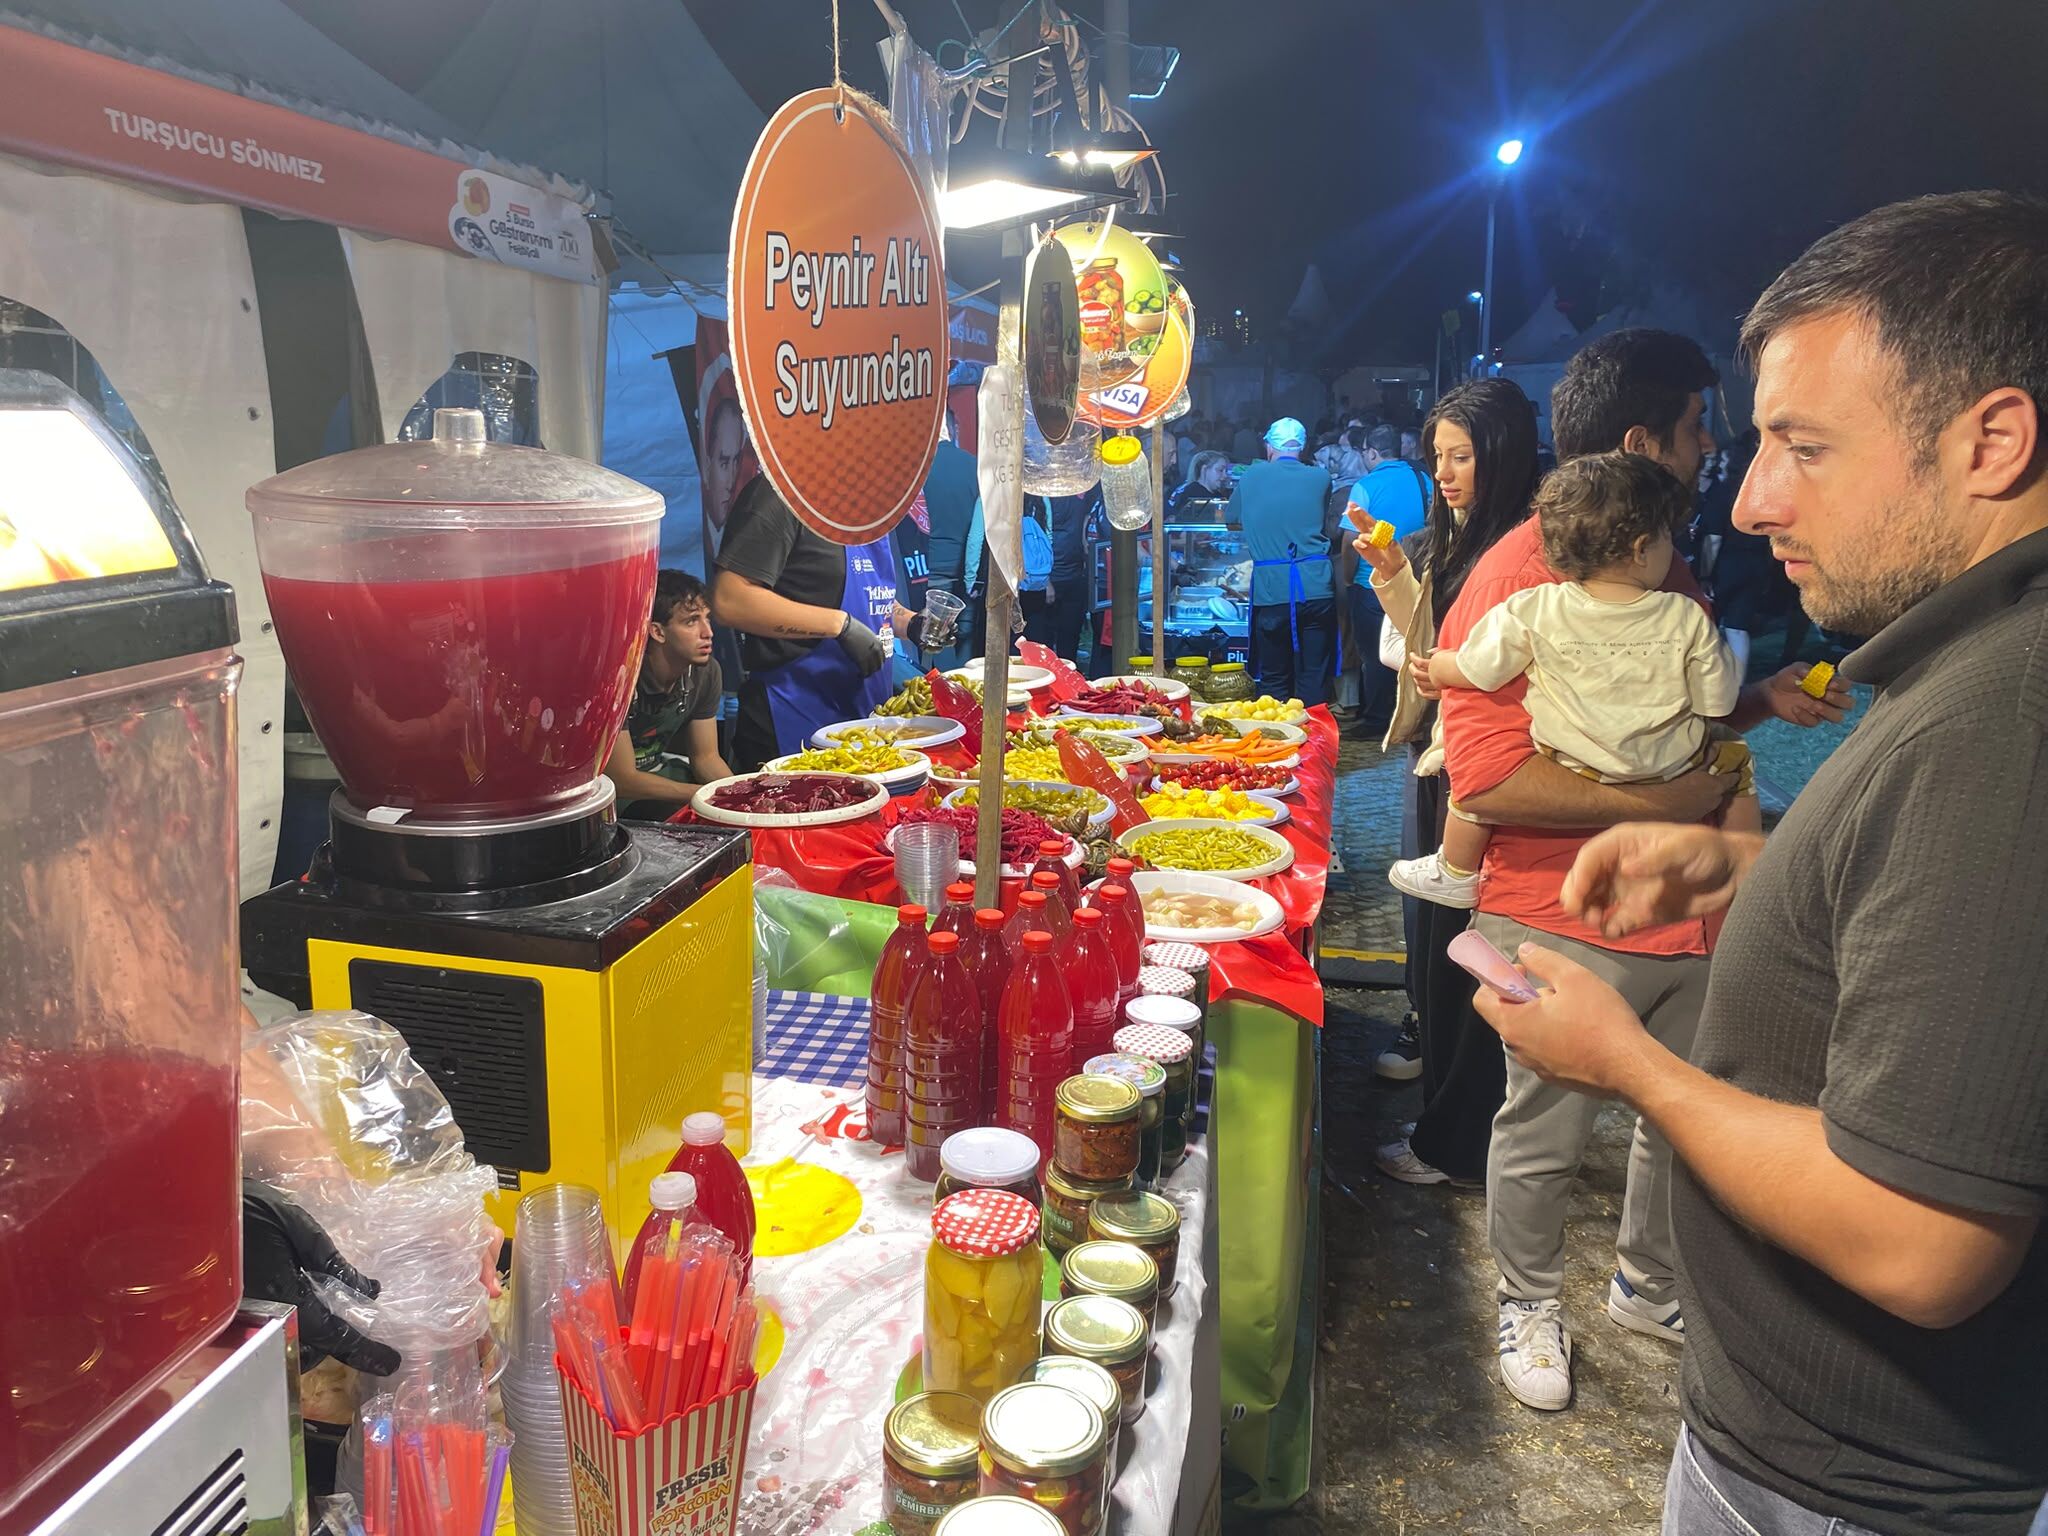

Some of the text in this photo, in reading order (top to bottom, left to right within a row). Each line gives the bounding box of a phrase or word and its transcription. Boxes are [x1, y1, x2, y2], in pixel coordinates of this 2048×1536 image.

[103, 107, 326, 184] TURŞUCU SÖNMEZ
[765, 231, 929, 329] Peynir Altı
[774, 334, 933, 430] Suyundan
[1103, 387, 1141, 408] VISA
[651, 1478, 733, 1533] POPCORN
[655, 1455, 729, 1510] FRESH
